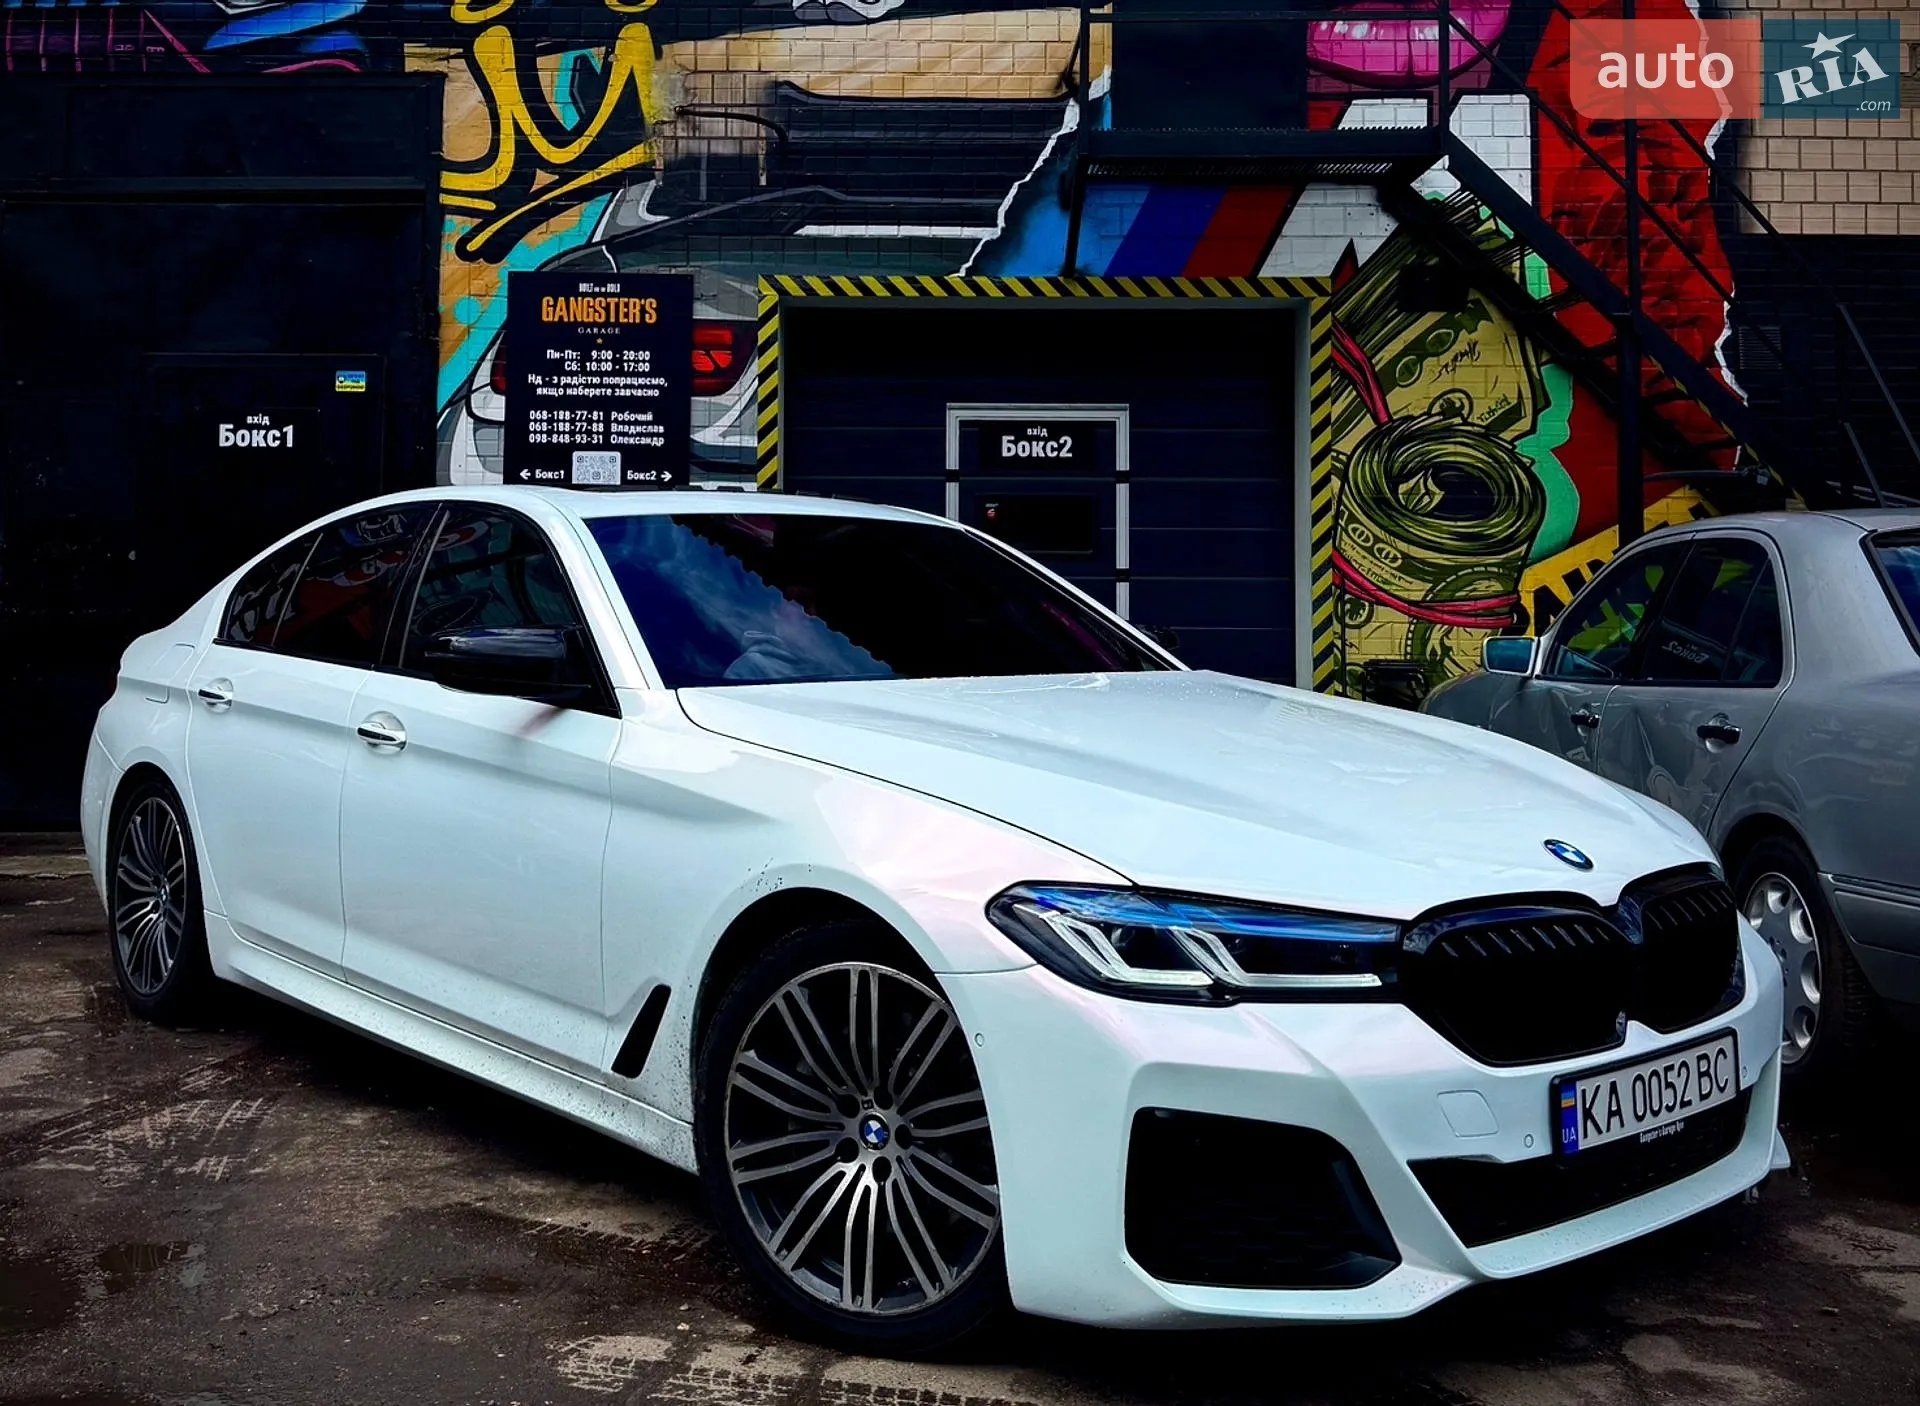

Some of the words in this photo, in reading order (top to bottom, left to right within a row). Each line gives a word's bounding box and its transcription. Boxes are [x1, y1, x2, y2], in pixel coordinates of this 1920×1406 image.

[541, 296, 657, 324] GANGSTER'S
[577, 327, 621, 335] GARAGE
[546, 349, 581, 360] Пн-Пт:
[591, 350, 613, 360] 9:00
[622, 350, 651, 361] 20:00
[564, 361, 581, 371] Сб:
[586, 361, 613, 371] 10:00
[623, 362, 650, 372] 17:00
[528, 373, 542, 385] Нд
[560, 374, 601, 386] радістю
[536, 386, 564, 397] якщо
[566, 385, 612, 398] наберете
[614, 388, 660, 396] завчасно
[246, 413, 270, 426] вхід
[529, 410, 604, 421] 068-188-77-81
[611, 411, 653, 421] Робочий
[529, 422, 604, 432] 068-188-77-88
[611, 423, 665, 434] Владислав
[1026, 425, 1048, 437] вхід
[218, 423, 294, 448] Бокс1
[528, 434, 603, 444] 098-848-93-31
[610, 434, 665, 446] Олександр
[1001, 435, 1073, 458] Бокс2
[535, 469, 565, 480] Бокс1
[627, 470, 657, 481] Бокс2
[1580, 1080, 1625, 1140] KA
[1631, 1059, 1693, 1122] 0052
[1696, 1047, 1729, 1101] BC
[1561, 1127, 1577, 1144] UA
